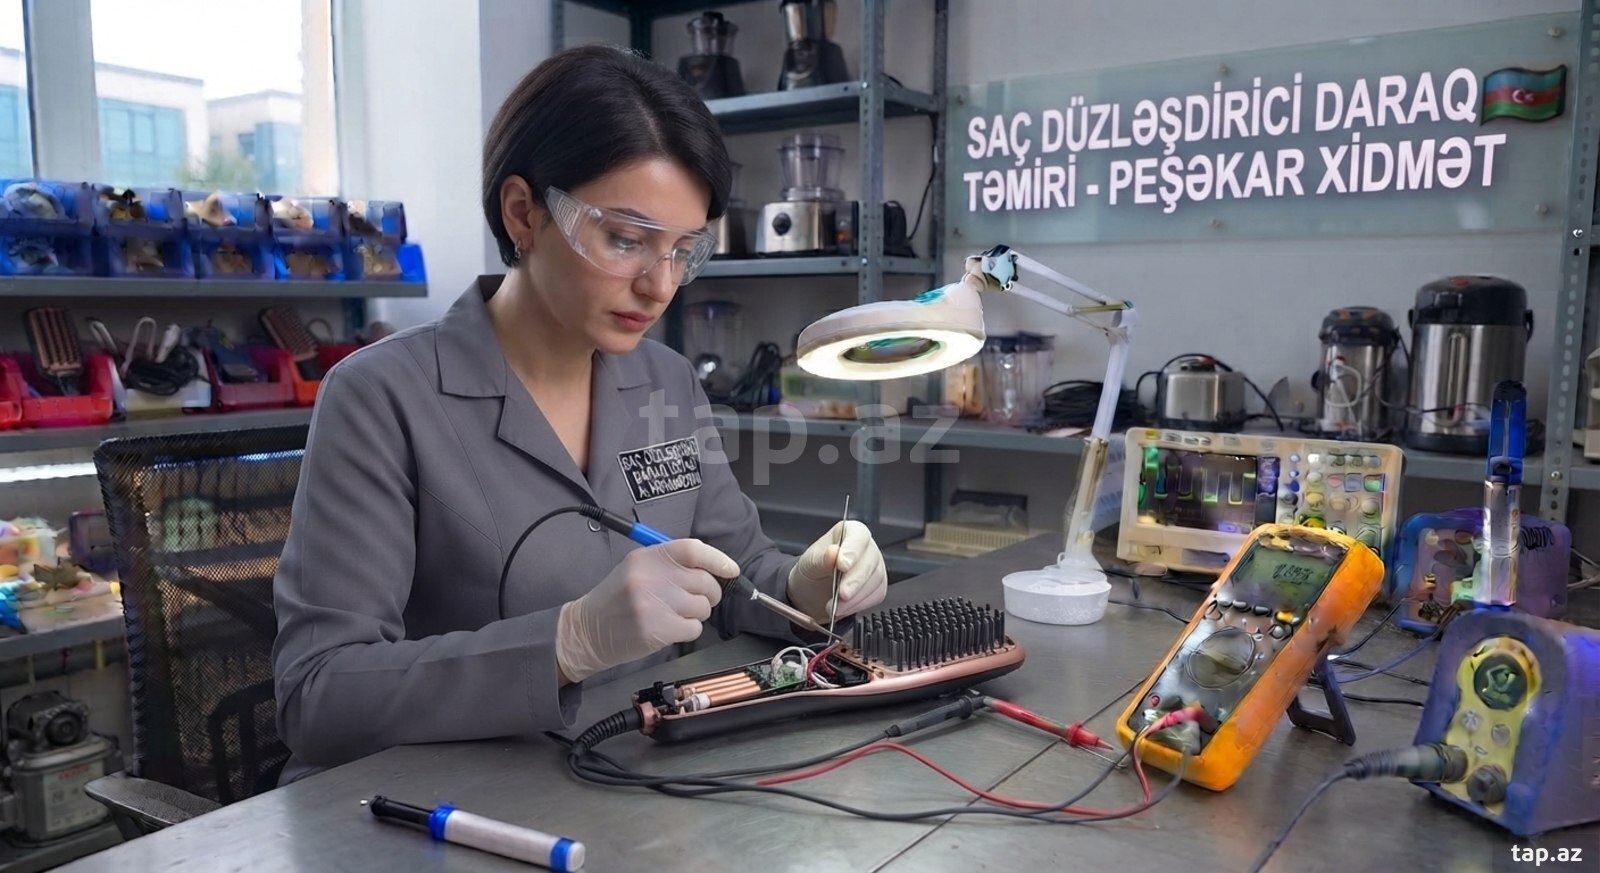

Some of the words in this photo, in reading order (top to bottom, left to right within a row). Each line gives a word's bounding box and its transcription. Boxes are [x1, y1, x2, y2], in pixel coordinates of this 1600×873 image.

[967, 112, 1032, 166] SAÇ
[1041, 72, 1302, 155] DÜZLƏŞDİRİCİ
[1315, 68, 1478, 132] DARAQ
[963, 154, 1076, 212] TƏMİRİ
[1109, 148, 1305, 214] PEŞƏKAR
[1316, 132, 1506, 194] XİDMƏT
